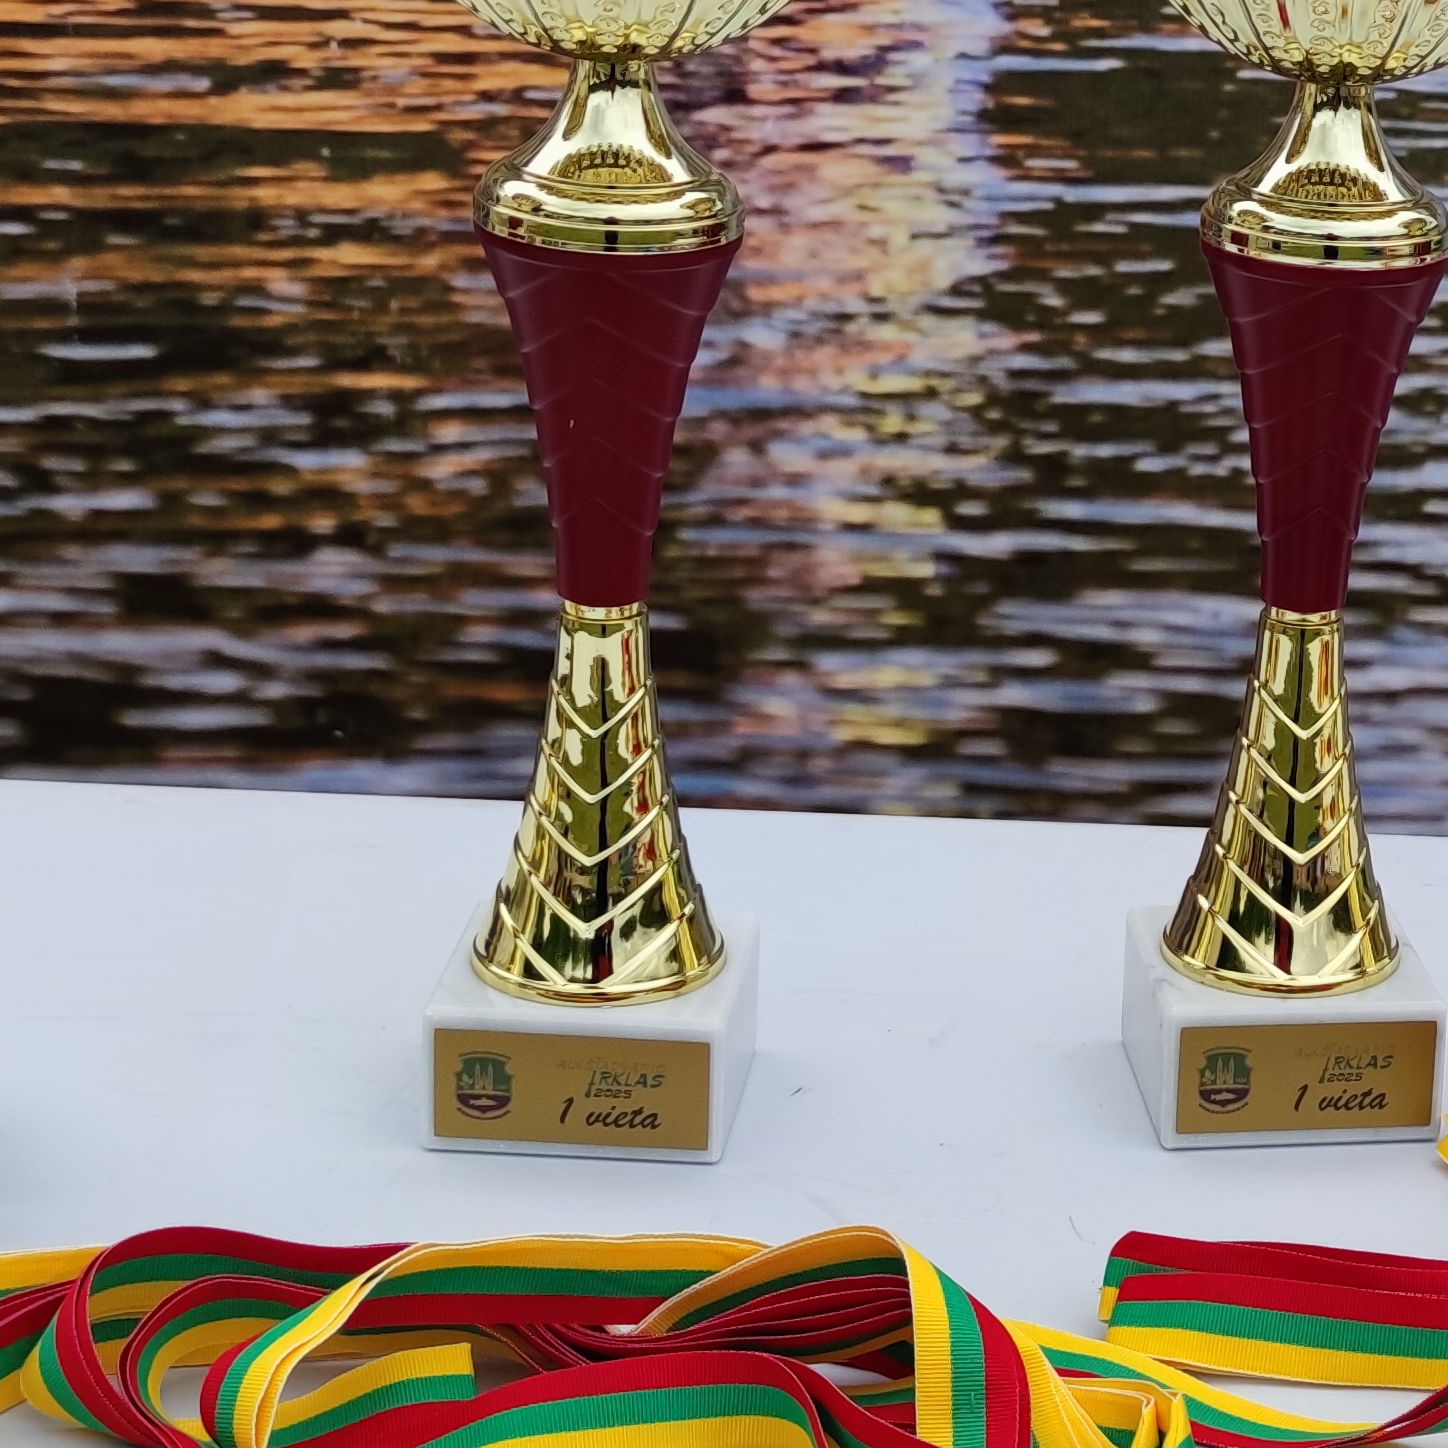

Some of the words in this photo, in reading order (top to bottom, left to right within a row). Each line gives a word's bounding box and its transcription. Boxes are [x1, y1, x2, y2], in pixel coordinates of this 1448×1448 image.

[1318, 1055, 1395, 1084] IRKLAS
[1326, 1072, 1364, 1083] 2025
[584, 1070, 666, 1099] IRKLAS
[593, 1088, 634, 1099] 2025
[1293, 1083, 1309, 1112] 1
[1318, 1087, 1390, 1112] vieta
[559, 1096, 575, 1125] 1
[585, 1105, 662, 1130] vieta
